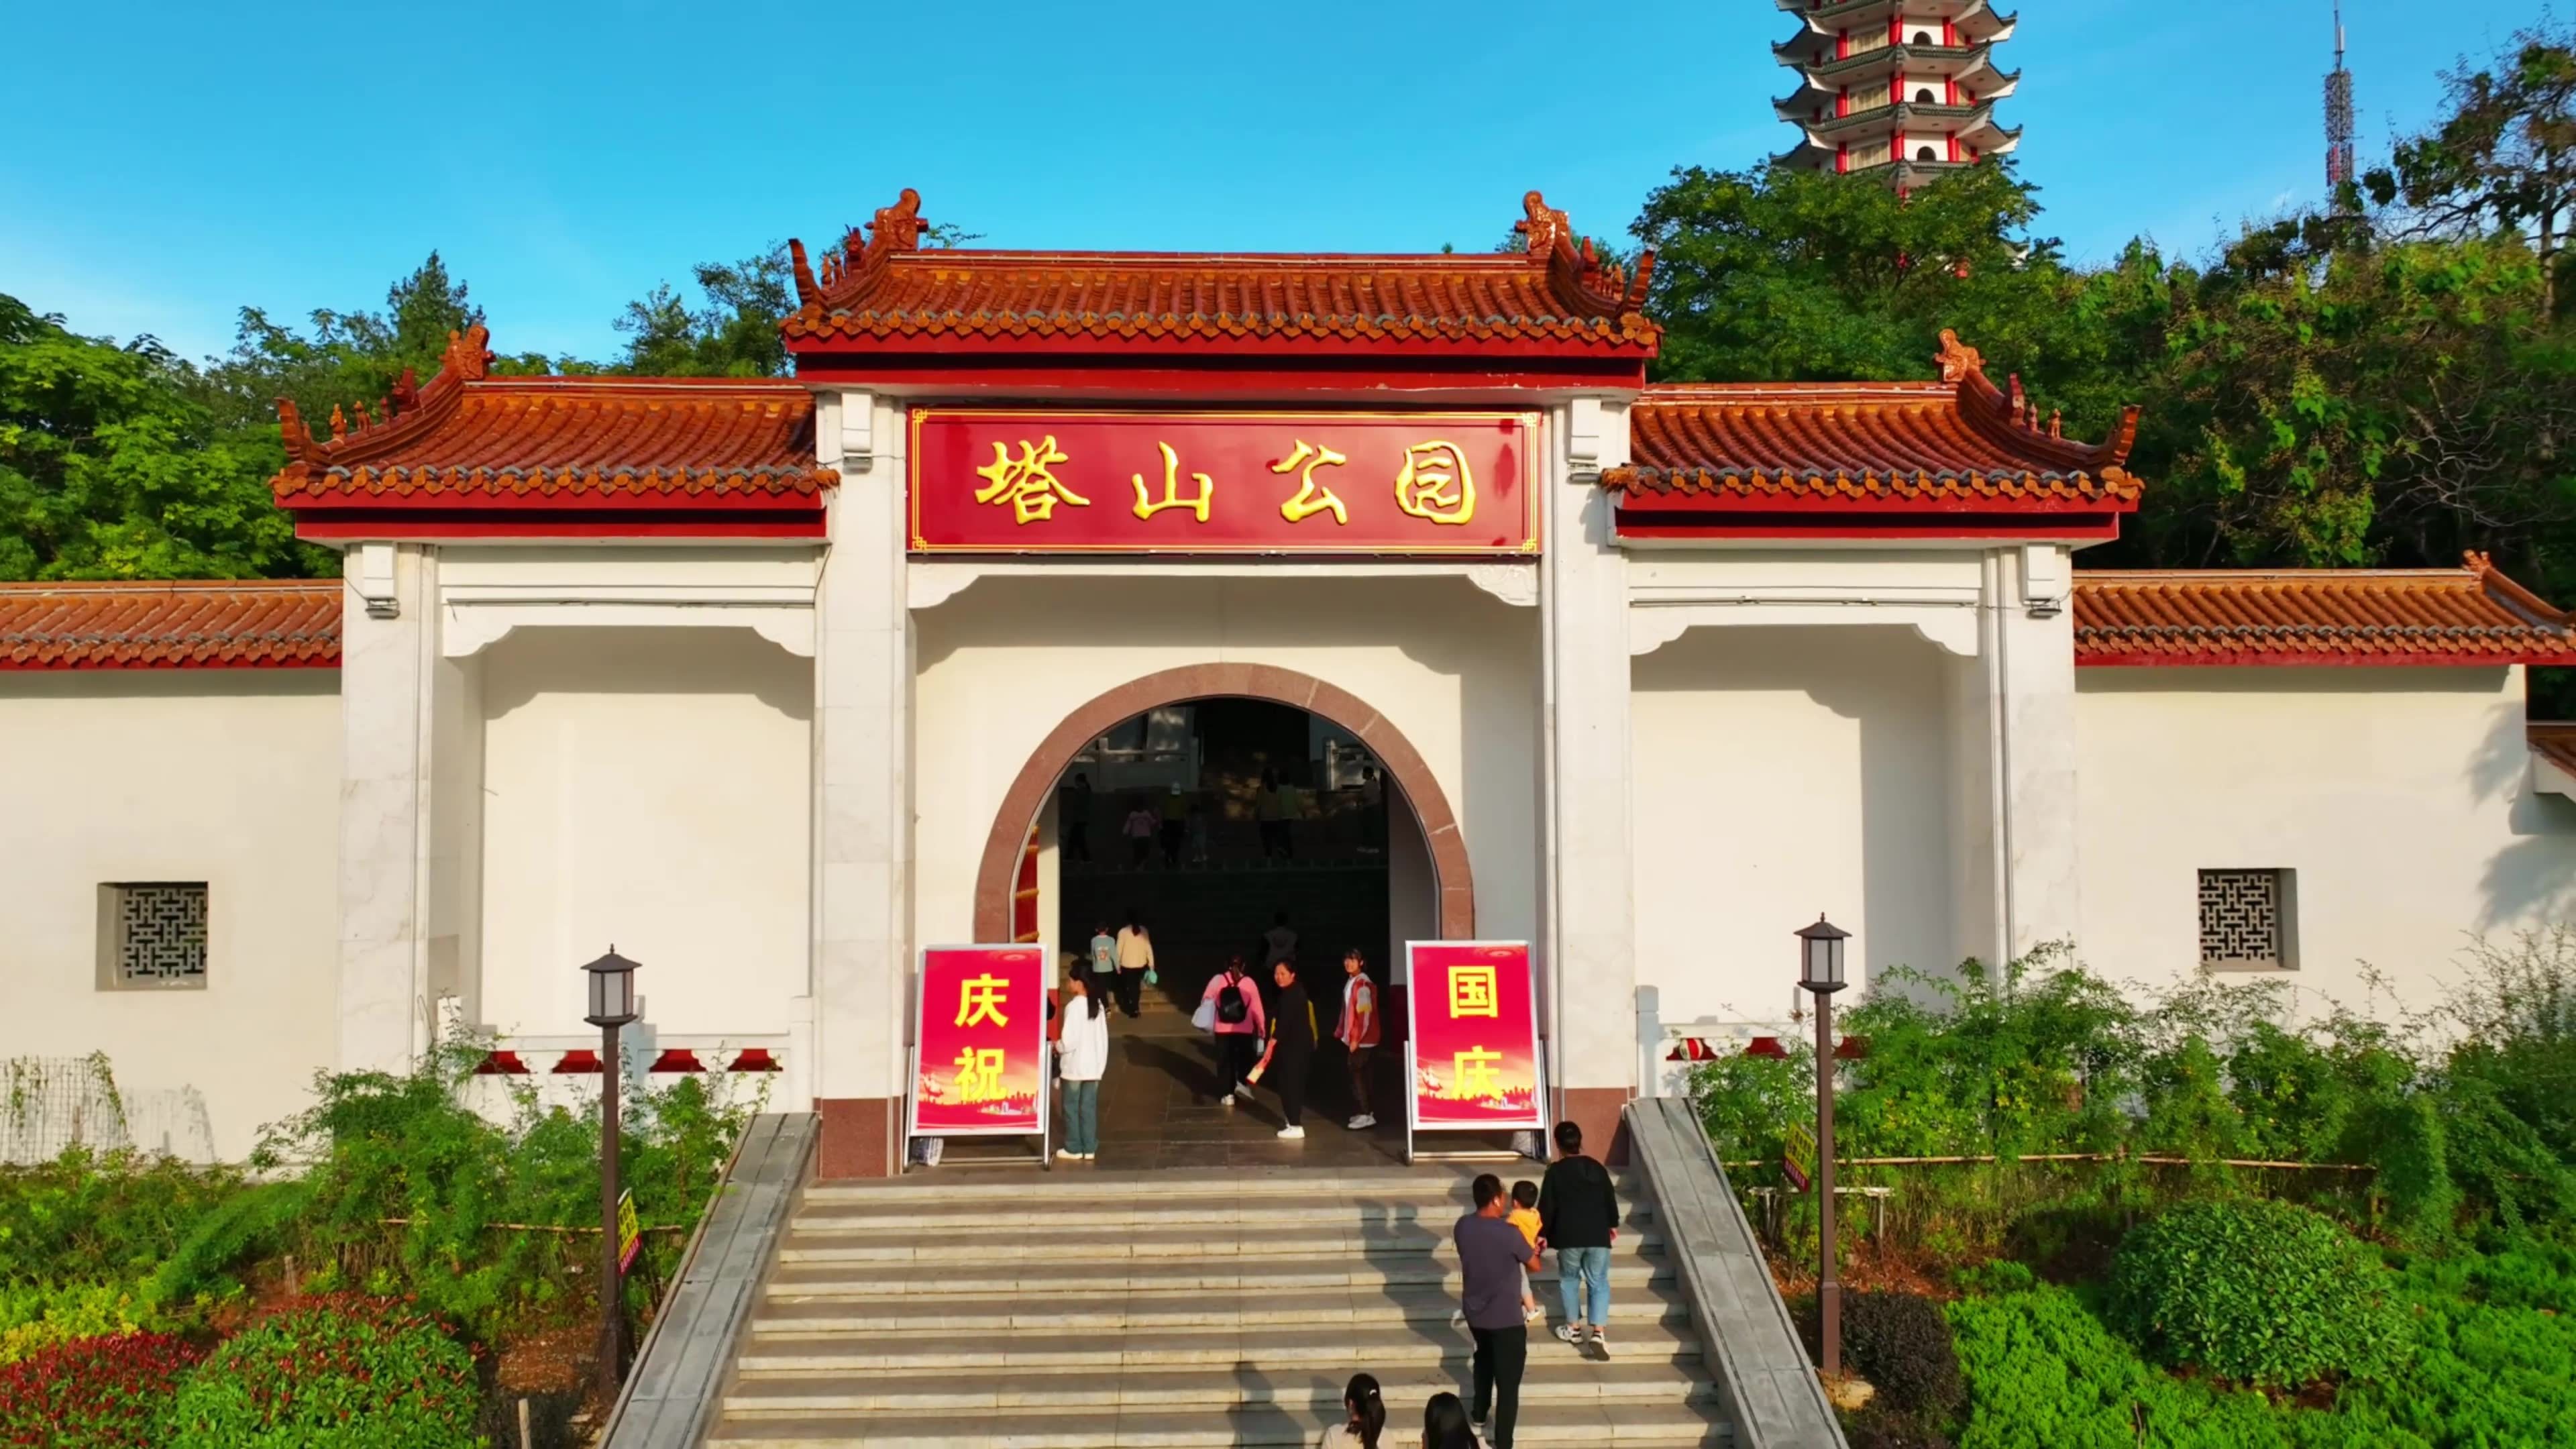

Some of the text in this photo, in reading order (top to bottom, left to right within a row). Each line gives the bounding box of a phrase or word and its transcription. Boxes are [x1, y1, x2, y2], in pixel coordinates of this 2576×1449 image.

[974, 434, 1478, 526] 塔山公园
[954, 973, 1010, 1102] 庆祝
[1448, 965, 1502, 1101] 国庆
